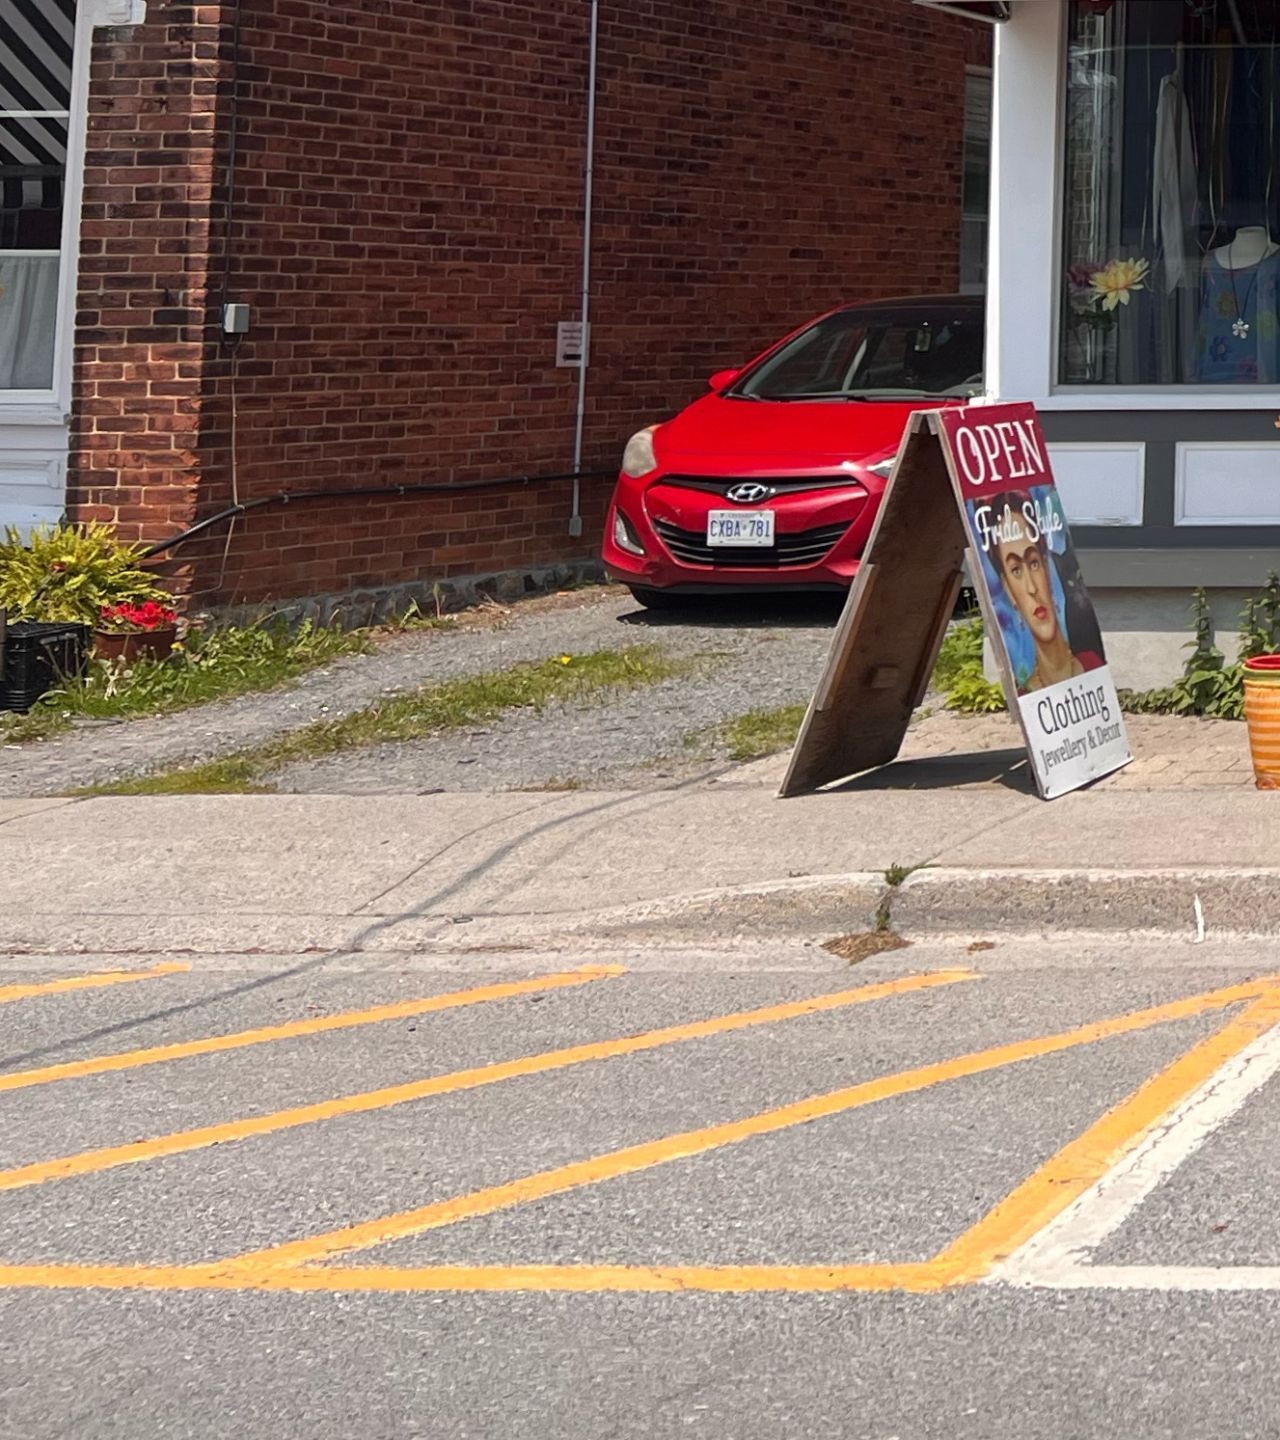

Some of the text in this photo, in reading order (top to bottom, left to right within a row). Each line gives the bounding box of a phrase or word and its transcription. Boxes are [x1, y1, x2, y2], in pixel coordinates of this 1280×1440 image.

[955, 419, 1045, 486] OPEN
[974, 496, 1063, 552] Frida Style
[1037, 684, 1111, 735] Clothing
[1040, 722, 1122, 777] Jewellery & Decor
